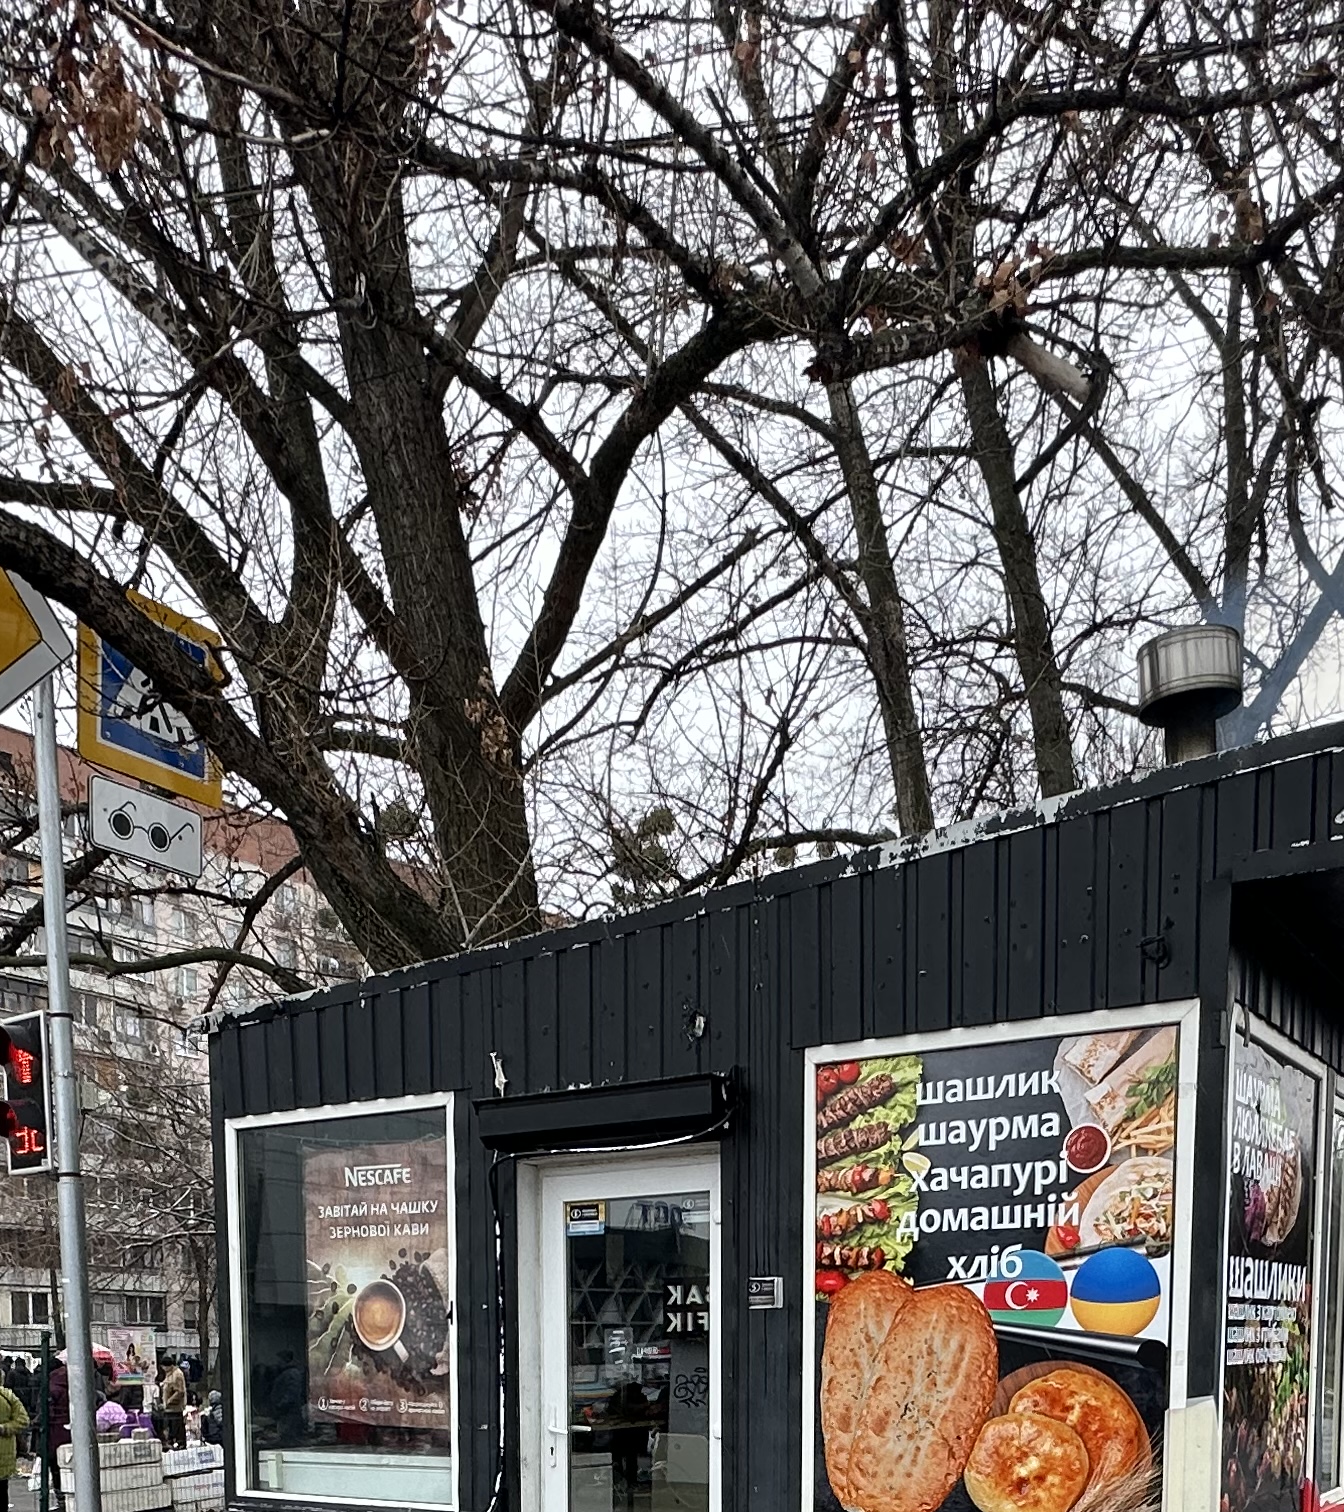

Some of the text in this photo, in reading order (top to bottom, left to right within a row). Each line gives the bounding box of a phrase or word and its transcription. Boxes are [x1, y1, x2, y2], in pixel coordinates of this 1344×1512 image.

[916, 1070, 1061, 1106] шашлик
[918, 1111, 1060, 1152] шаурма
[911, 1151, 1068, 1196] хачапурі
[317, 1200, 439, 1219] ЗАВІТАЙ НА ЧАШКУ
[897, 1192, 1080, 1242] домашній
[329, 1220, 429, 1239] ЗЕРНОВОЇ КАВИ
[947, 1243, 1023, 1280] хліб
